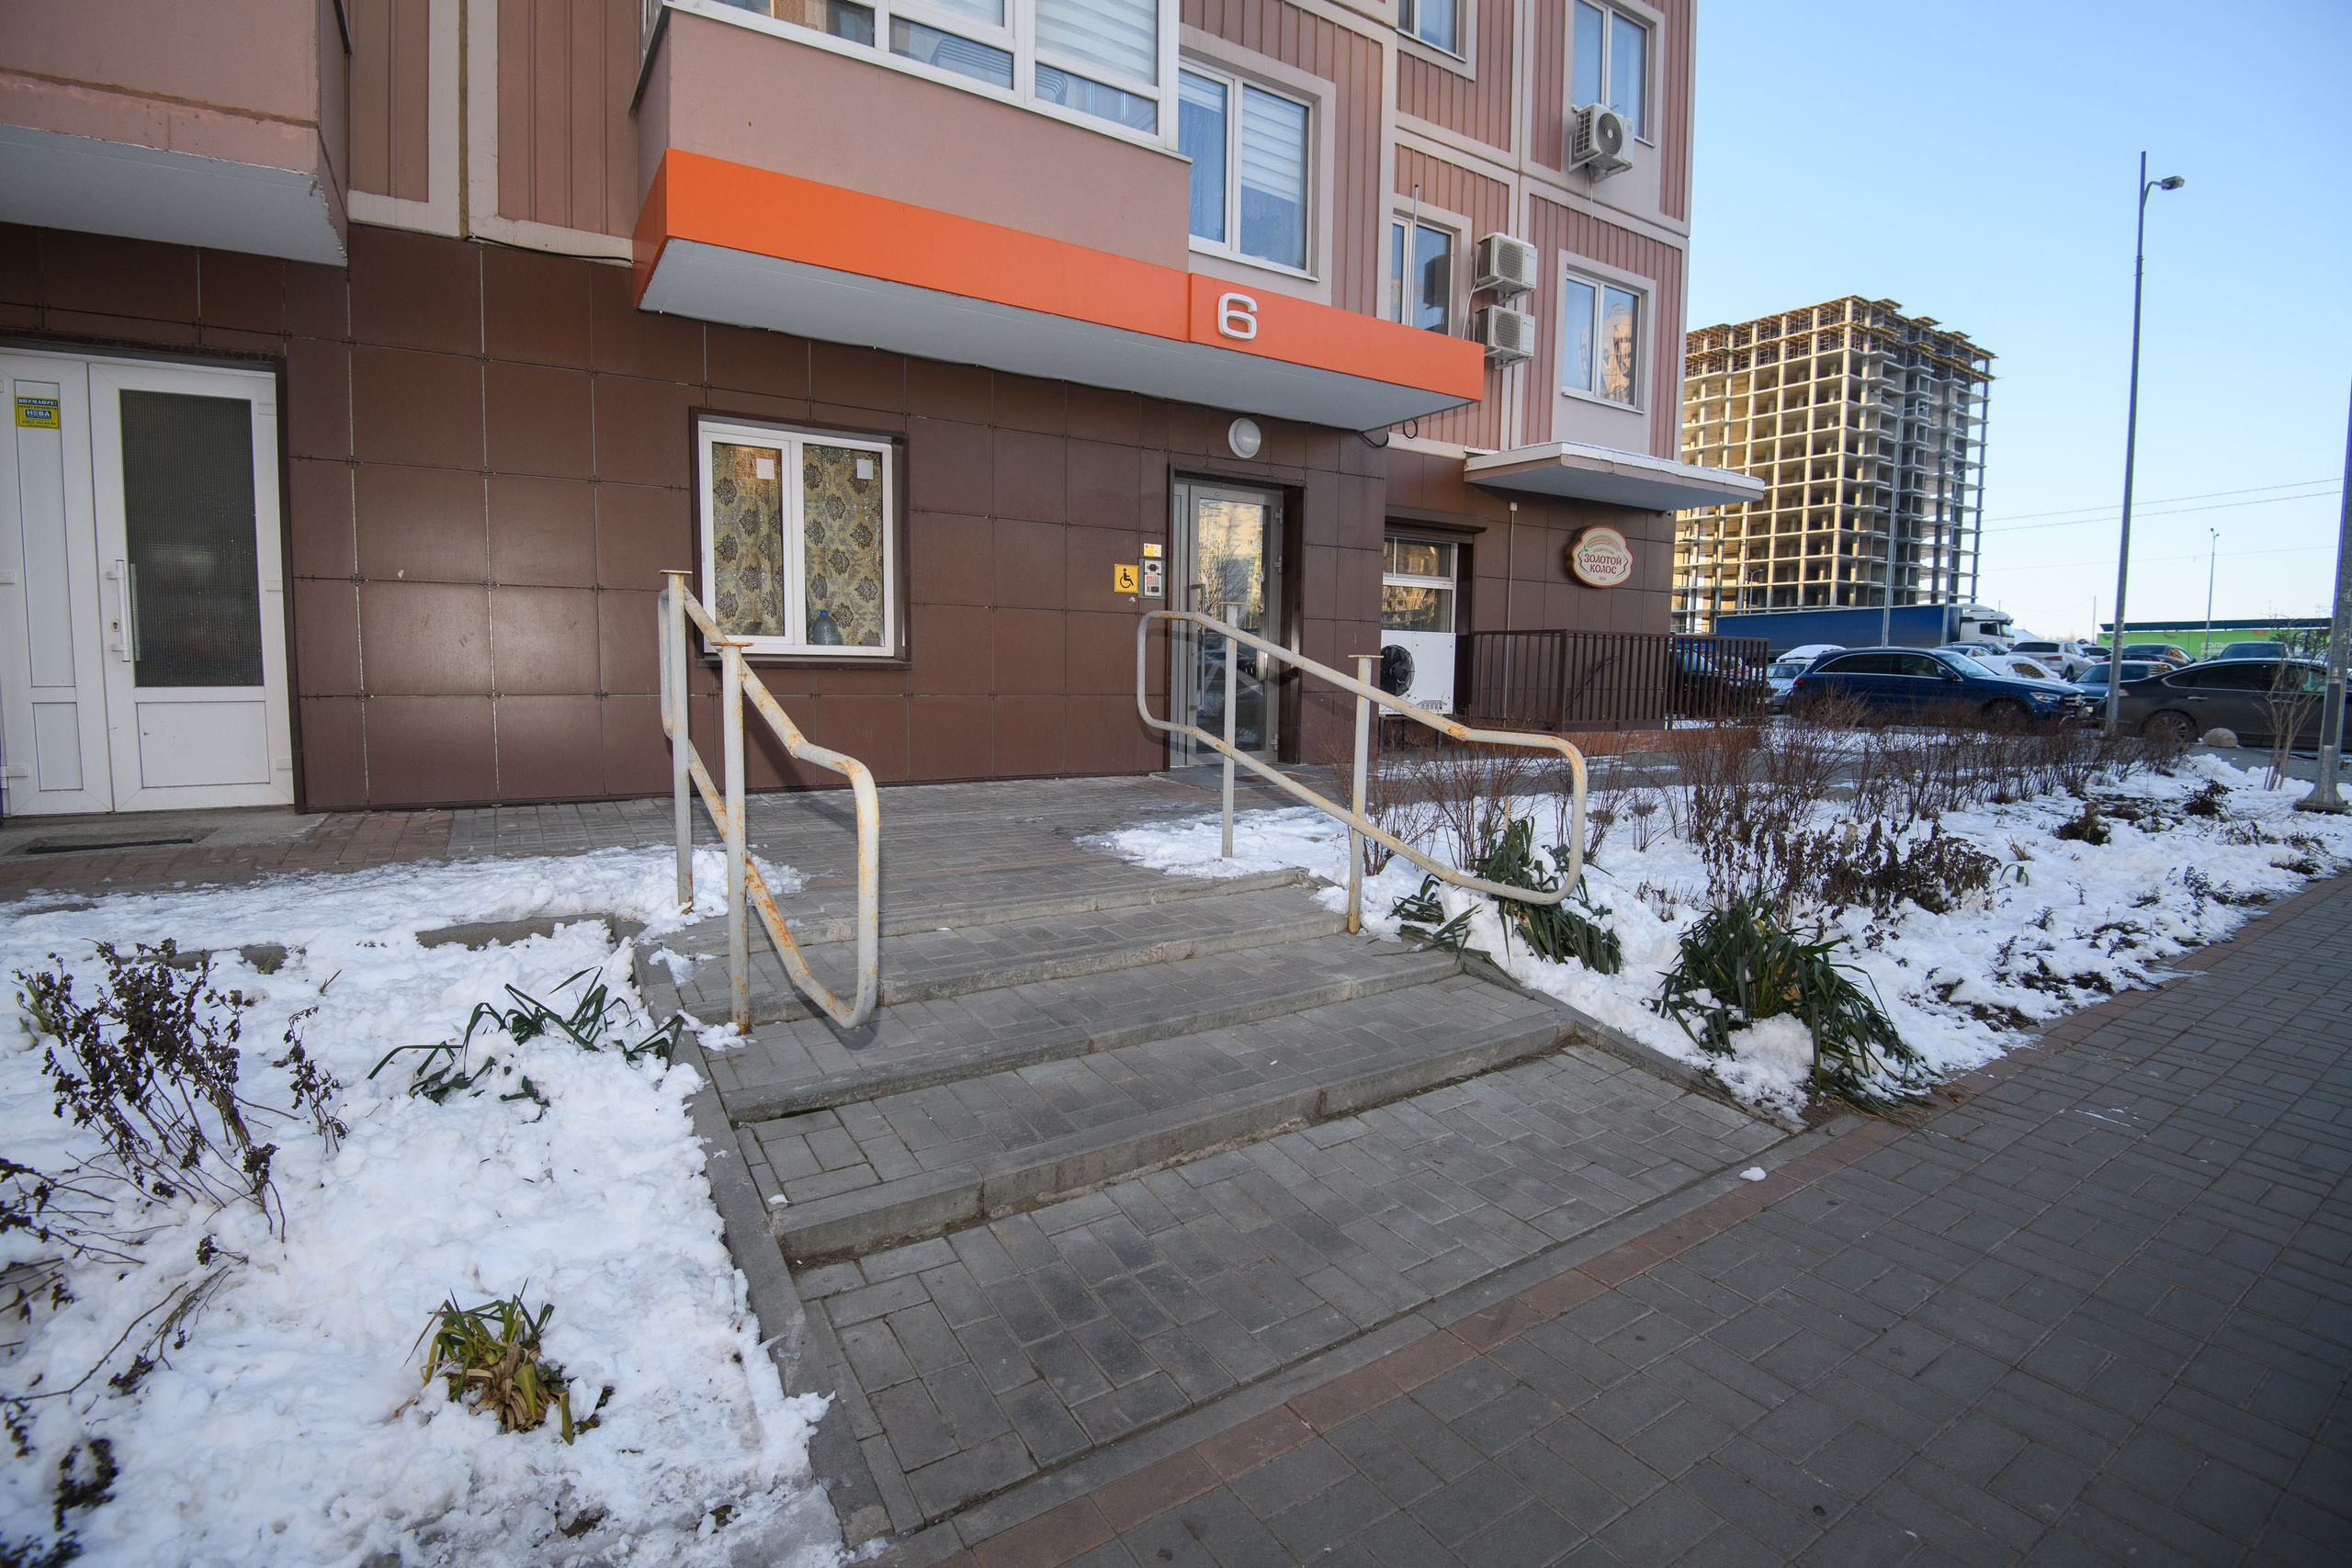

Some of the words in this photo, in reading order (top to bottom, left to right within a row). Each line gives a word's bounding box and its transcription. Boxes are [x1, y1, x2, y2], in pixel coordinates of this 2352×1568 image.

[1217, 292, 1258, 340] 6
[1584, 553, 1623, 566] ЗОЛОТОЙ
[1589, 563, 1617, 575] КОЛОС
